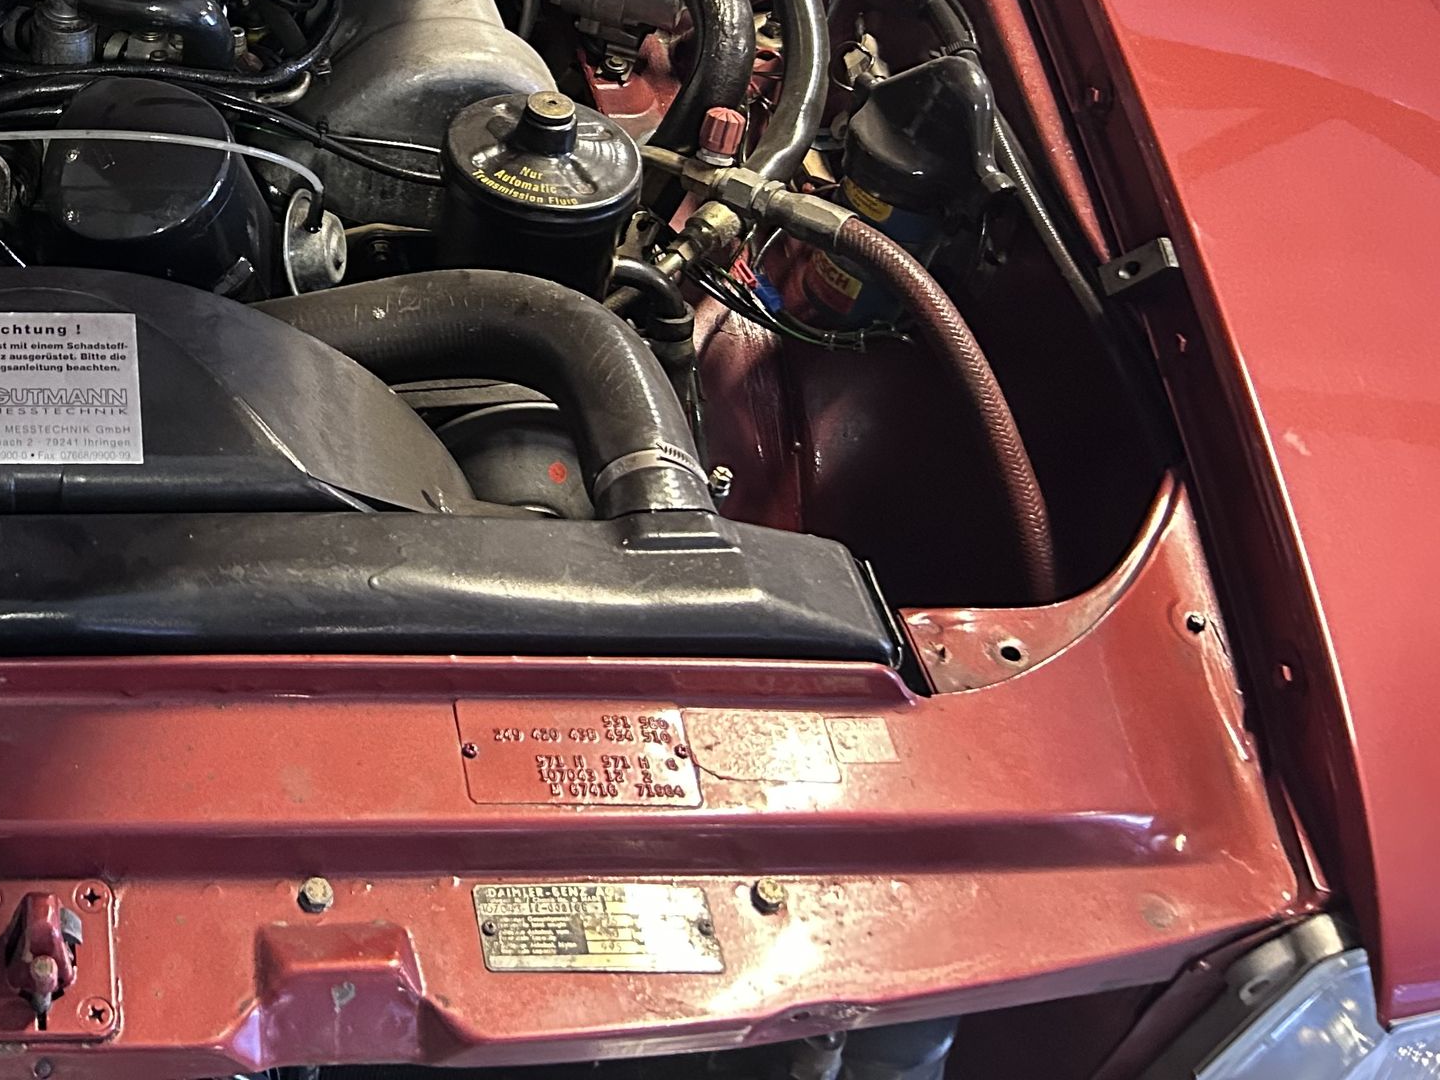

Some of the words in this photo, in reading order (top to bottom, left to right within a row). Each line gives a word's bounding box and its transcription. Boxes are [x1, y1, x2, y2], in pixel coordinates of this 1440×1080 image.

[519, 166, 543, 180] Nur
[494, 169, 557, 194] Automatic
[471, 169, 544, 204] Transmission
[549, 196, 579, 206] Fluid
[10, 342, 28, 350] mit
[31, 342, 64, 350] einem
[66, 342, 128, 350] Schadstoff-
[9, 352, 77, 362] ausgerüstet.
[80, 353, 107, 361] Bitte
[110, 353, 126, 361] die
[66, 364, 120, 372] beachten.
[5, 425, 90, 434] MESSTECHNIK
[95, 425, 131, 434] GmbH
[26, 438, 33, 447] 2
[46, 438, 78, 447] 79241
[84, 438, 131, 448] Ihringen
[486, 886, 588, 898] DAIMLER-BENZ
